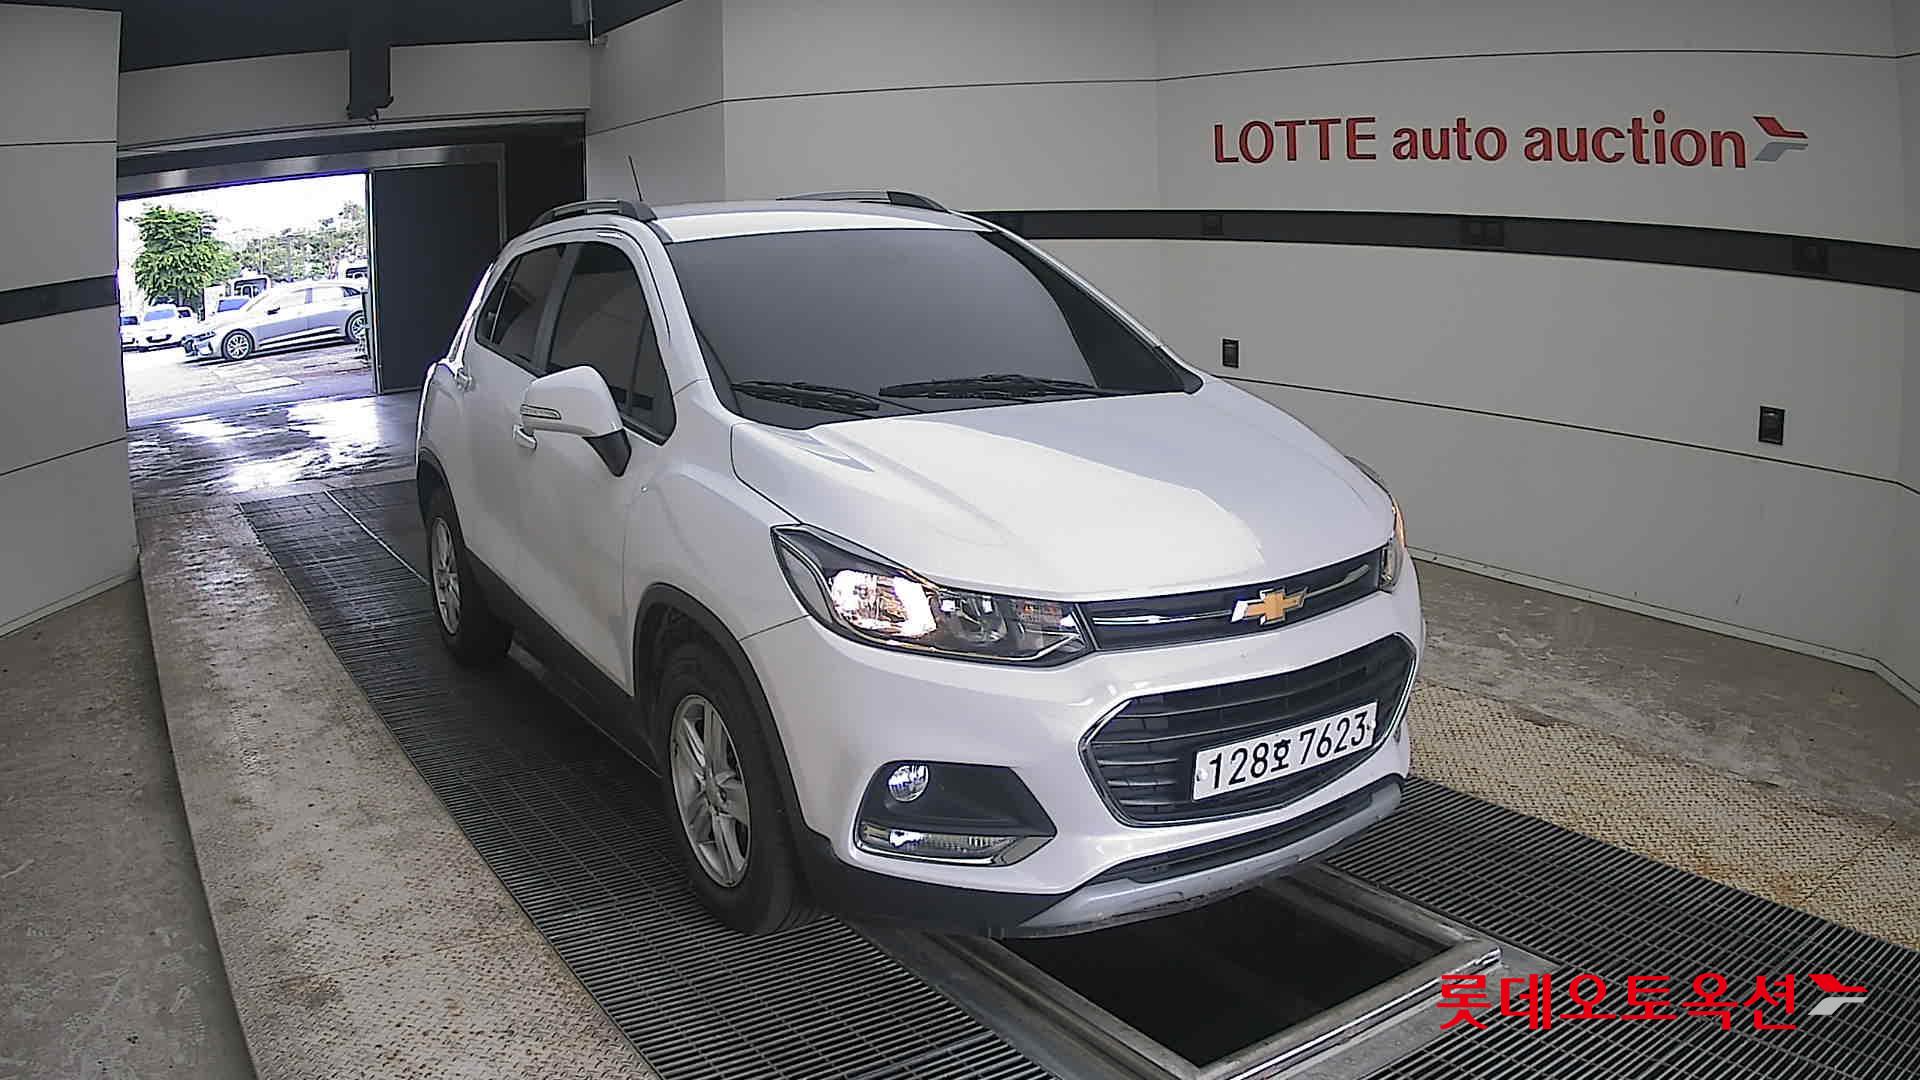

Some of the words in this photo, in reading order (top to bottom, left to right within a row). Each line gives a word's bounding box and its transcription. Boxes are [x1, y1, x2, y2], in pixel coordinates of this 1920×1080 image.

[1214, 116, 1377, 164] LOTTE
[1392, 116, 1509, 162] auto
[1523, 109, 1747, 169] auction
[1209, 739, 1292, 790] 128호
[1299, 711, 1369, 765] 7623
